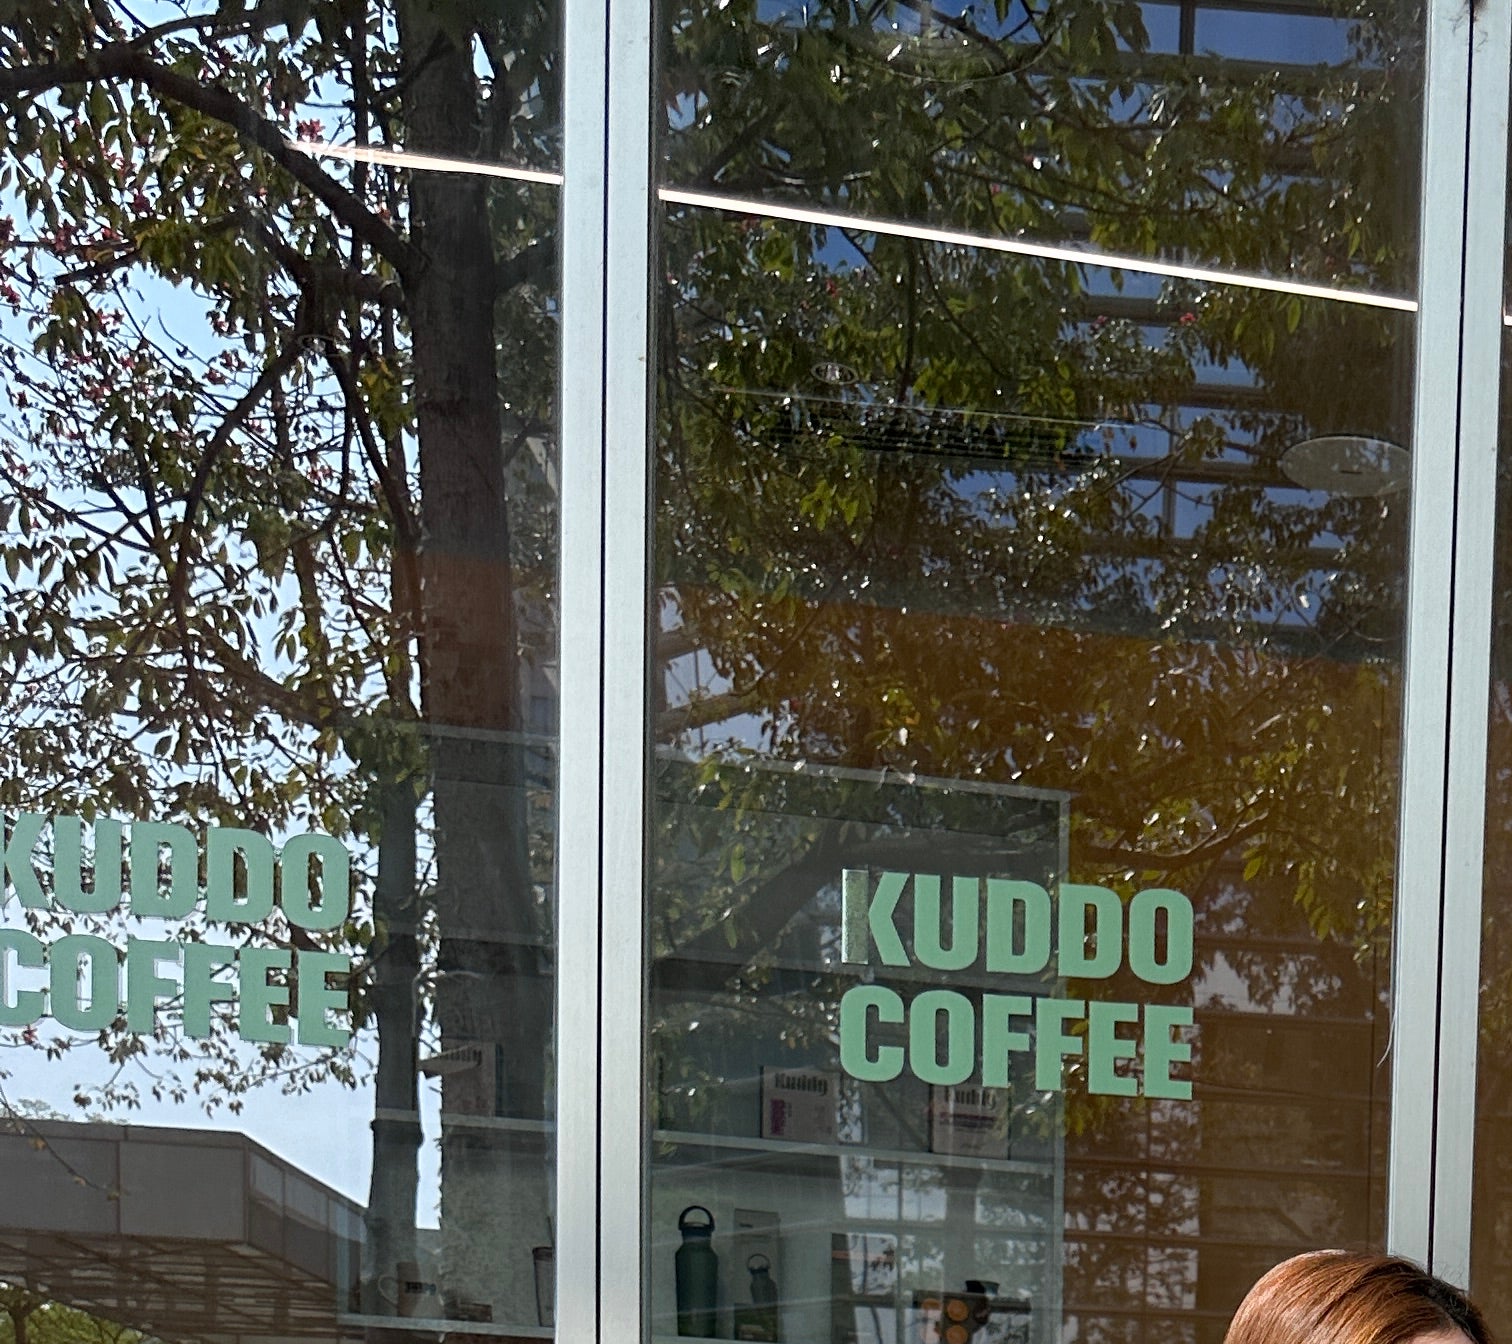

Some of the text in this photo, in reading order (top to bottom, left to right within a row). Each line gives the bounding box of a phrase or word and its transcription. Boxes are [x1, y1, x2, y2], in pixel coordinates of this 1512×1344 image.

[0, 812, 350, 930] KUDDO
[840, 868, 1193, 985] KUDDO
[0, 928, 350, 1048] COFFEE
[839, 984, 1193, 1100] COFFEE
